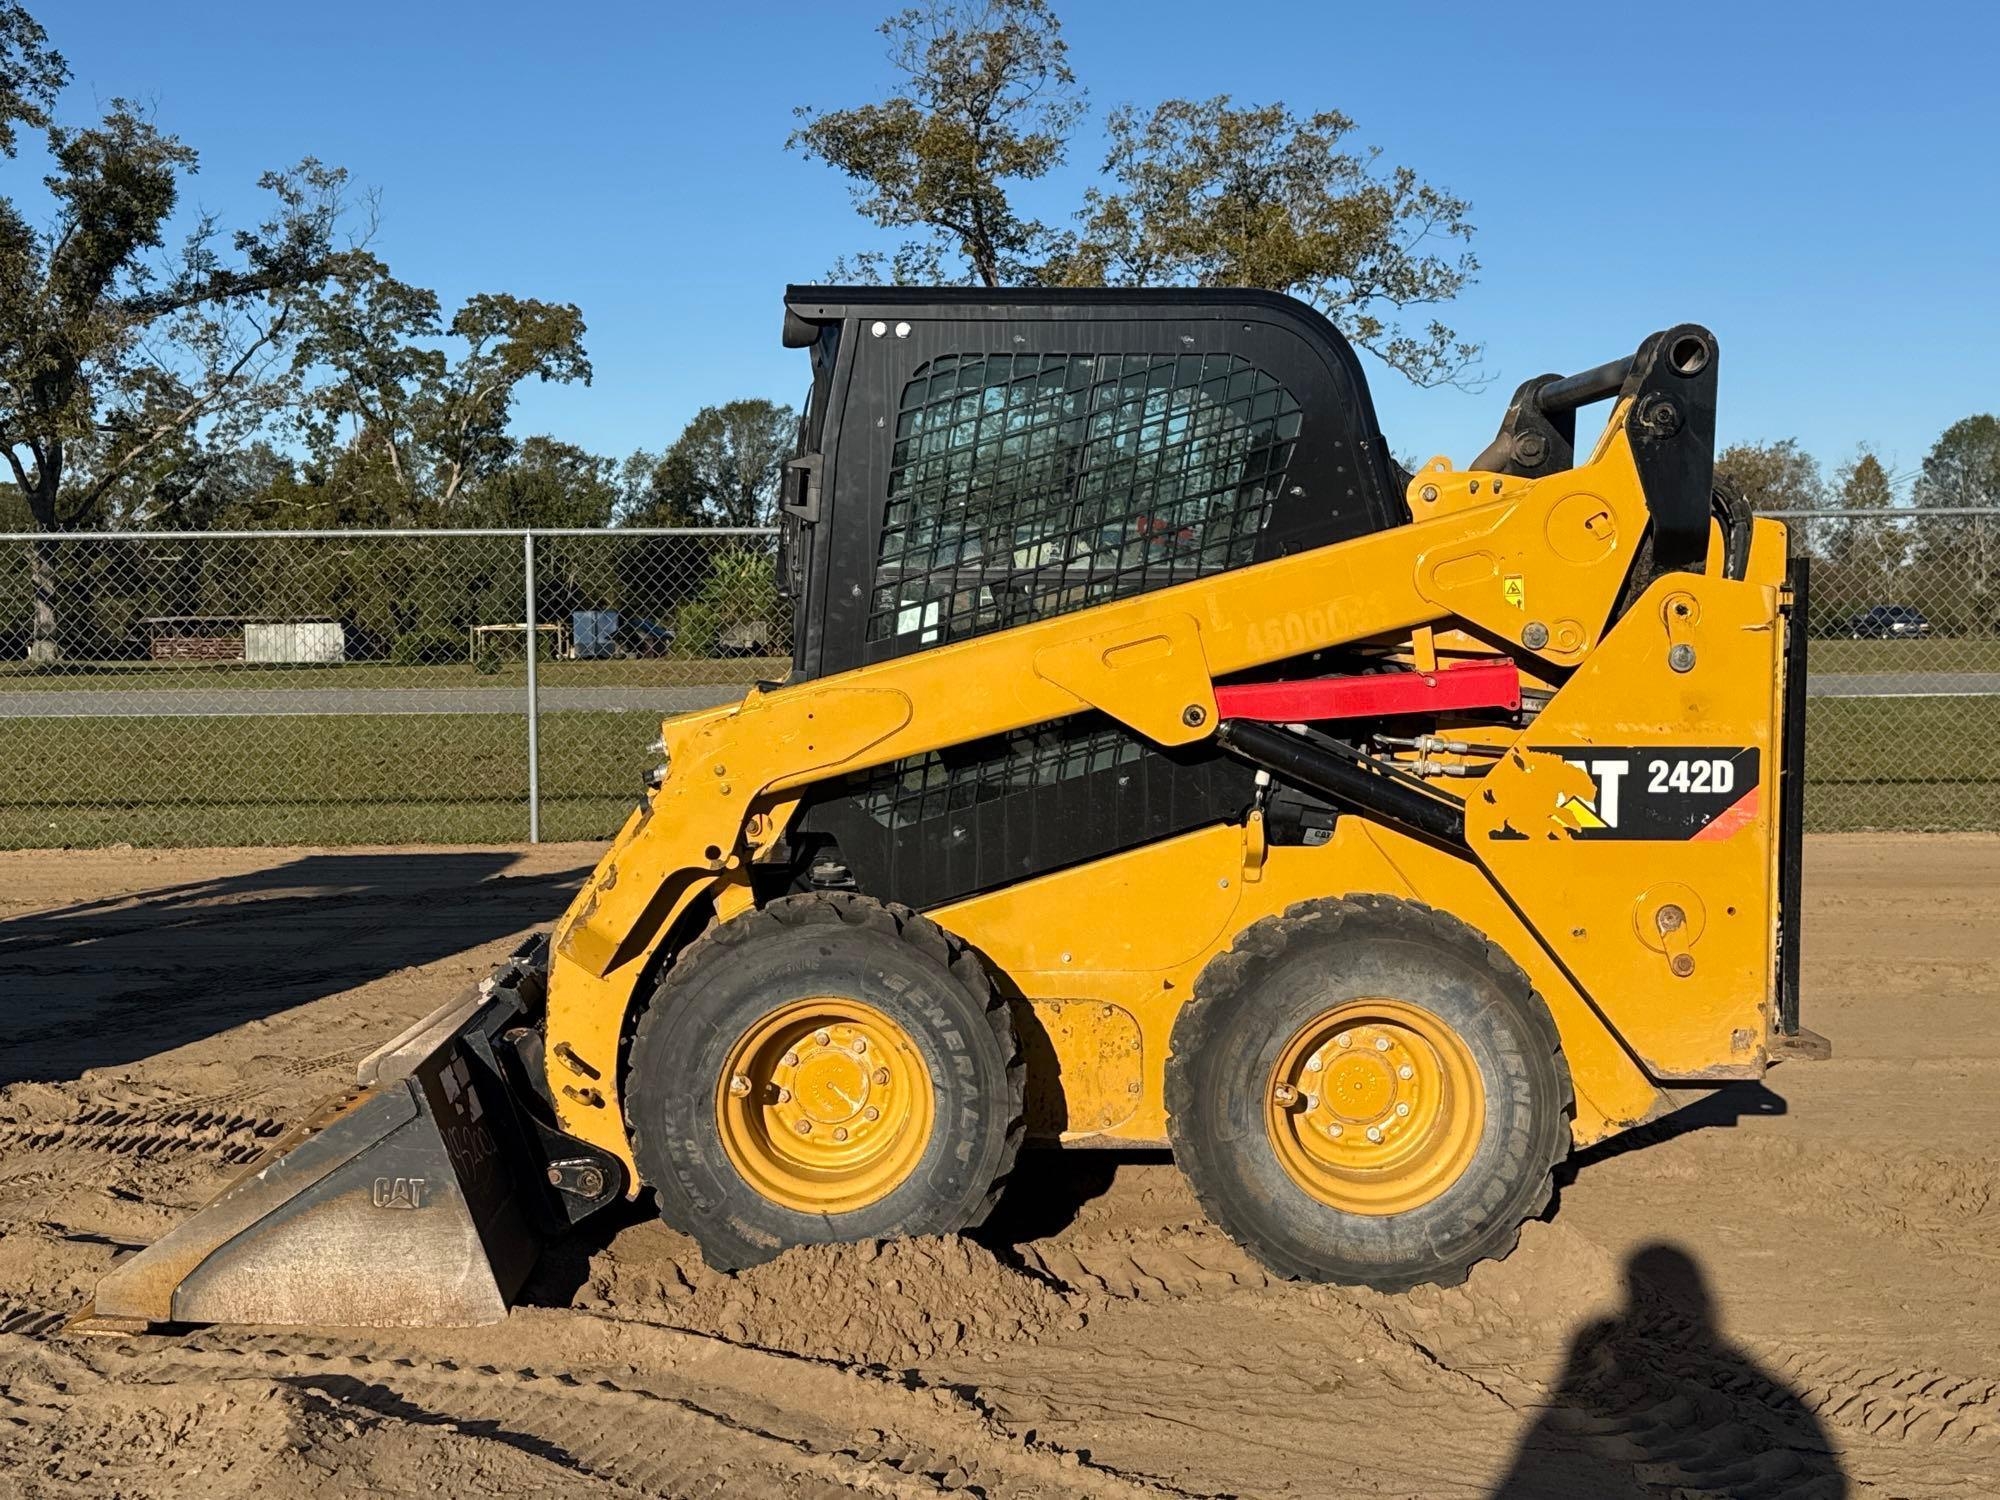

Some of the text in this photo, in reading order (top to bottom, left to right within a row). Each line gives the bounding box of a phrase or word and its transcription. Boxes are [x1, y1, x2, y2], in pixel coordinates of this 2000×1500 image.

[1648, 759, 1734, 793] 242D
[882, 972, 979, 1129] GENERAL
[373, 1176, 425, 1208] CAT
